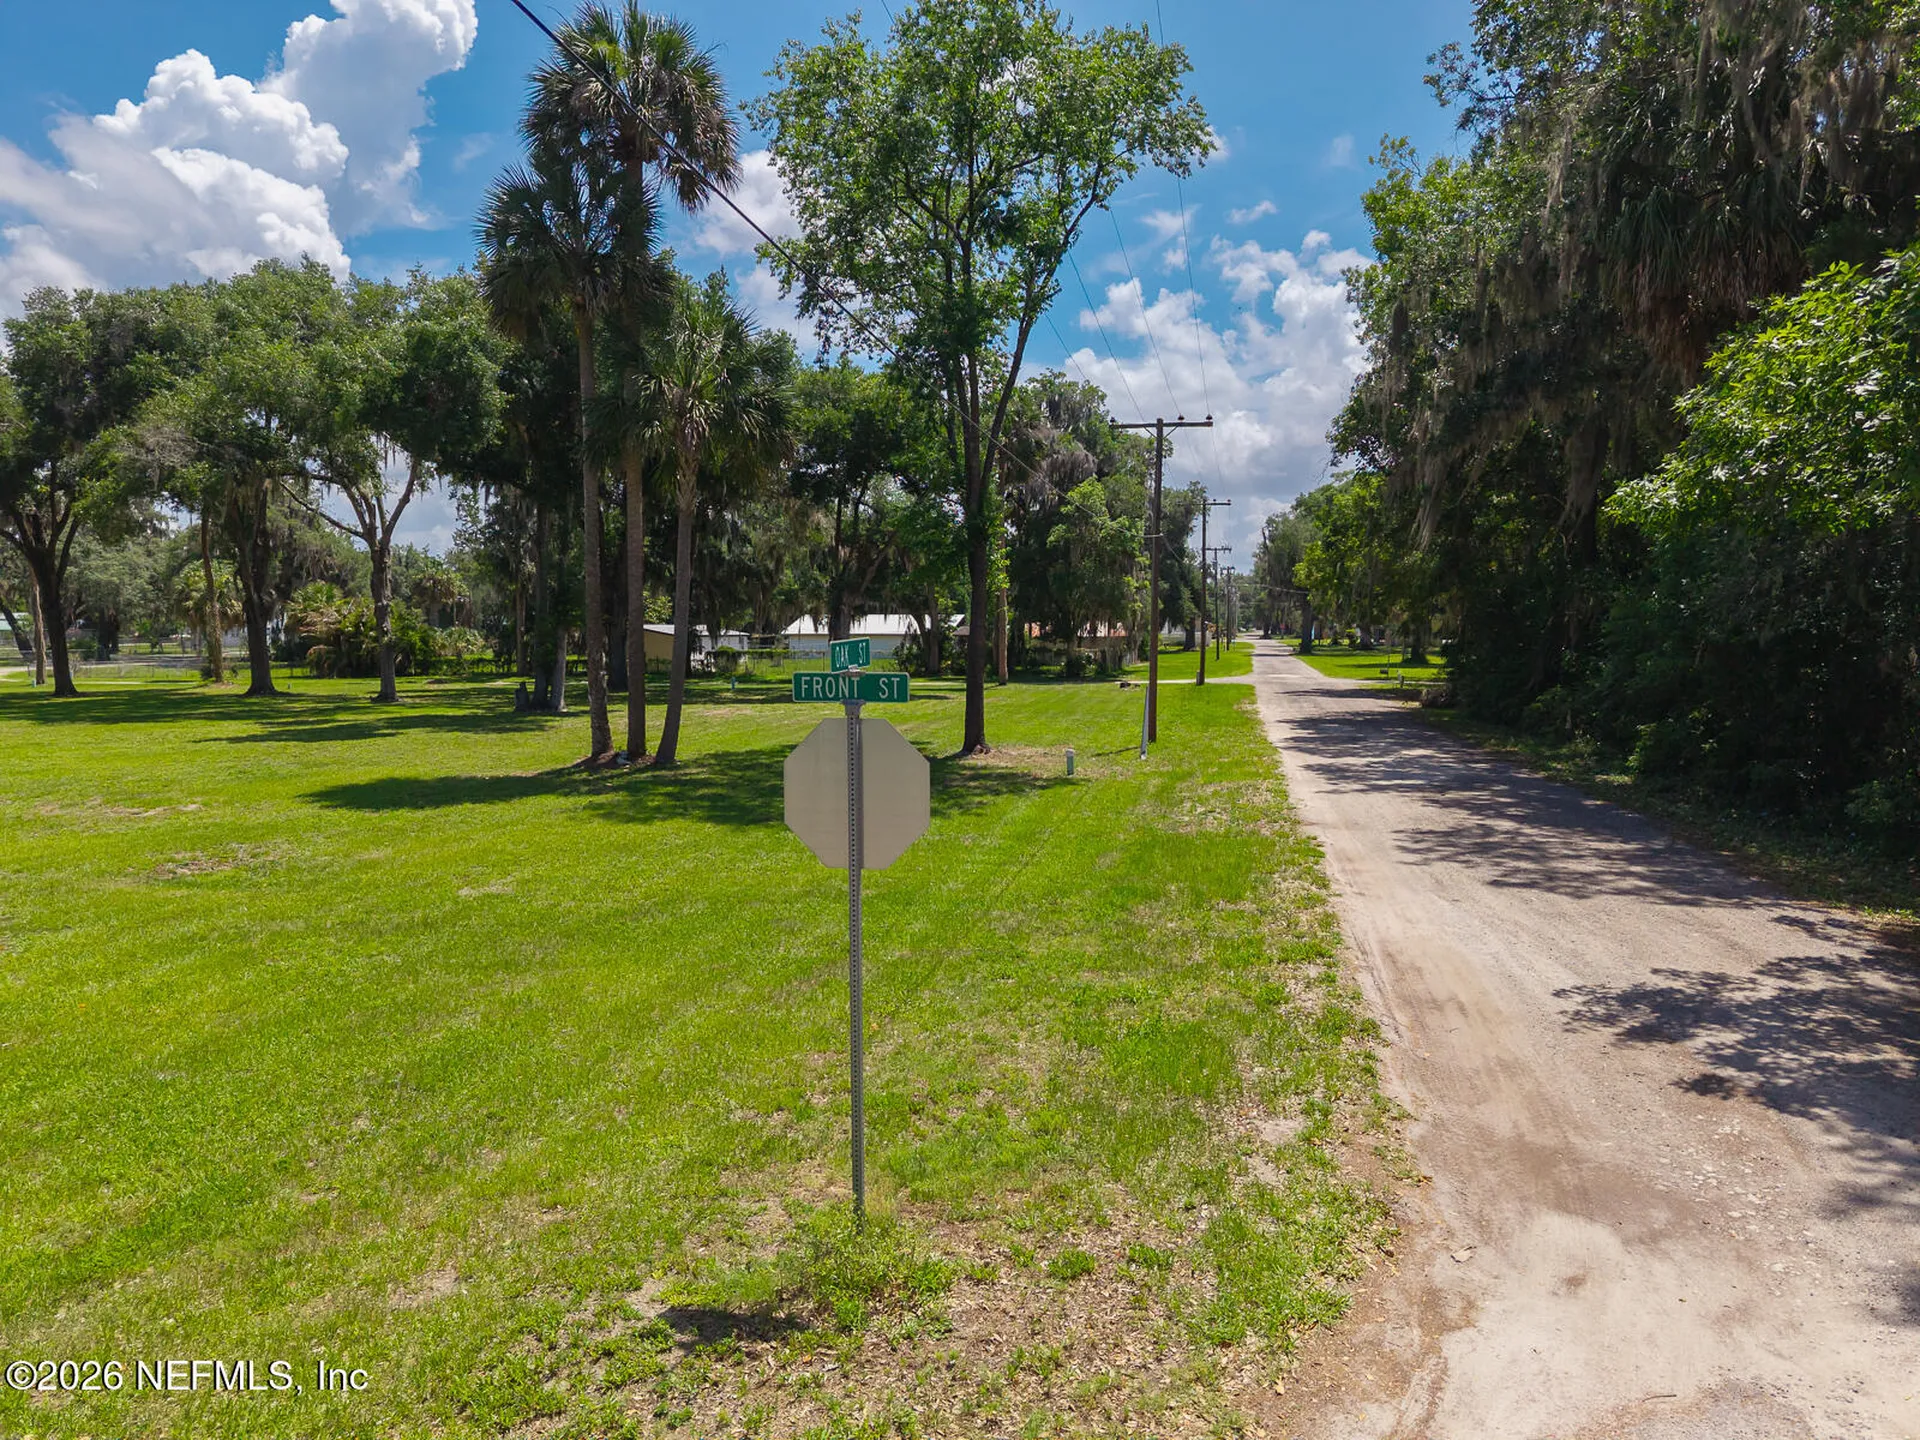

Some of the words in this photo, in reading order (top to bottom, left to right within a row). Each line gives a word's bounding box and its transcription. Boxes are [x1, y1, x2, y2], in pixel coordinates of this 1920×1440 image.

[834, 644, 849, 668] OAK
[858, 642, 866, 664] ST
[801, 676, 860, 699] FRONT
[879, 677, 900, 699] ST
